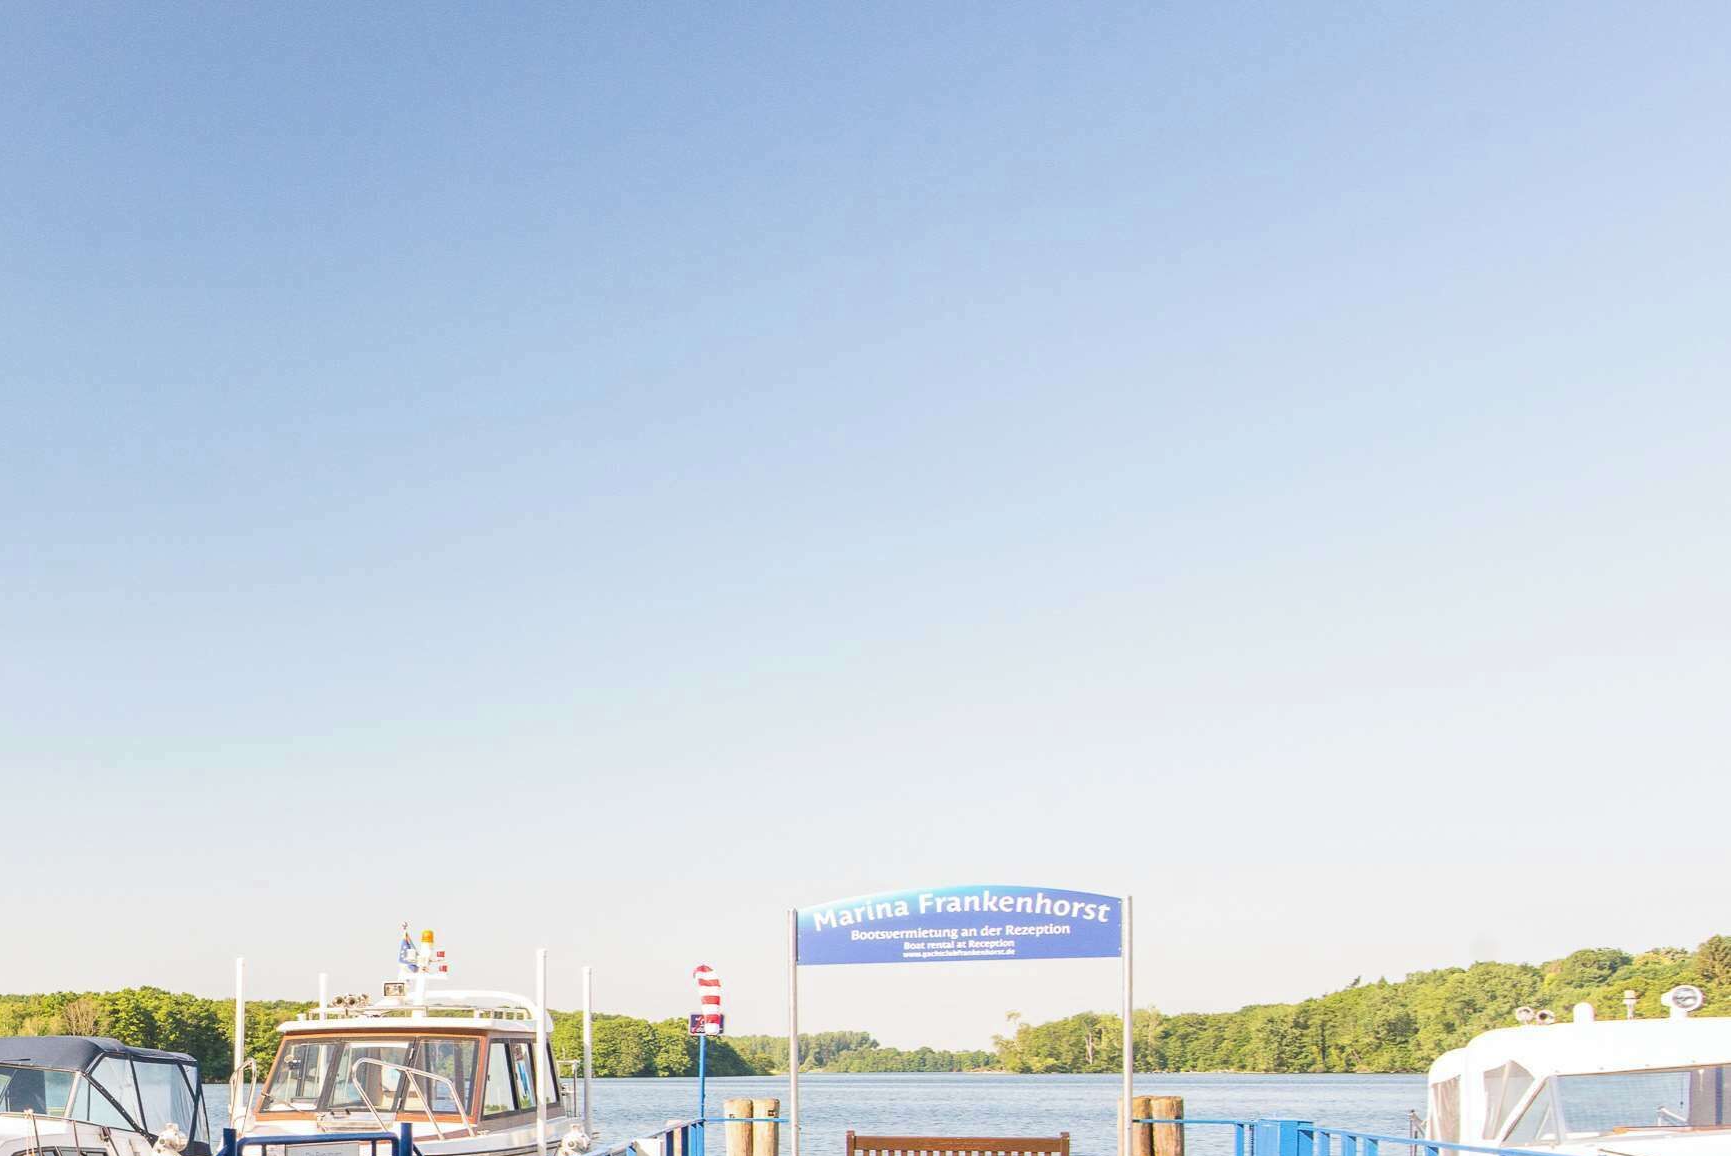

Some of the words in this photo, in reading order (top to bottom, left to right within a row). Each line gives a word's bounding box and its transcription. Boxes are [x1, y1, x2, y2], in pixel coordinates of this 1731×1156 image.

[813, 899, 909, 931] Marina
[919, 890, 1110, 923] Frankenhorst
[851, 928, 959, 941] Bootsvermietung
[961, 928, 977, 937] an
[980, 925, 1002, 936] der
[1005, 924, 1070, 937] Rezeption
[968, 939, 1015, 949] Reception
